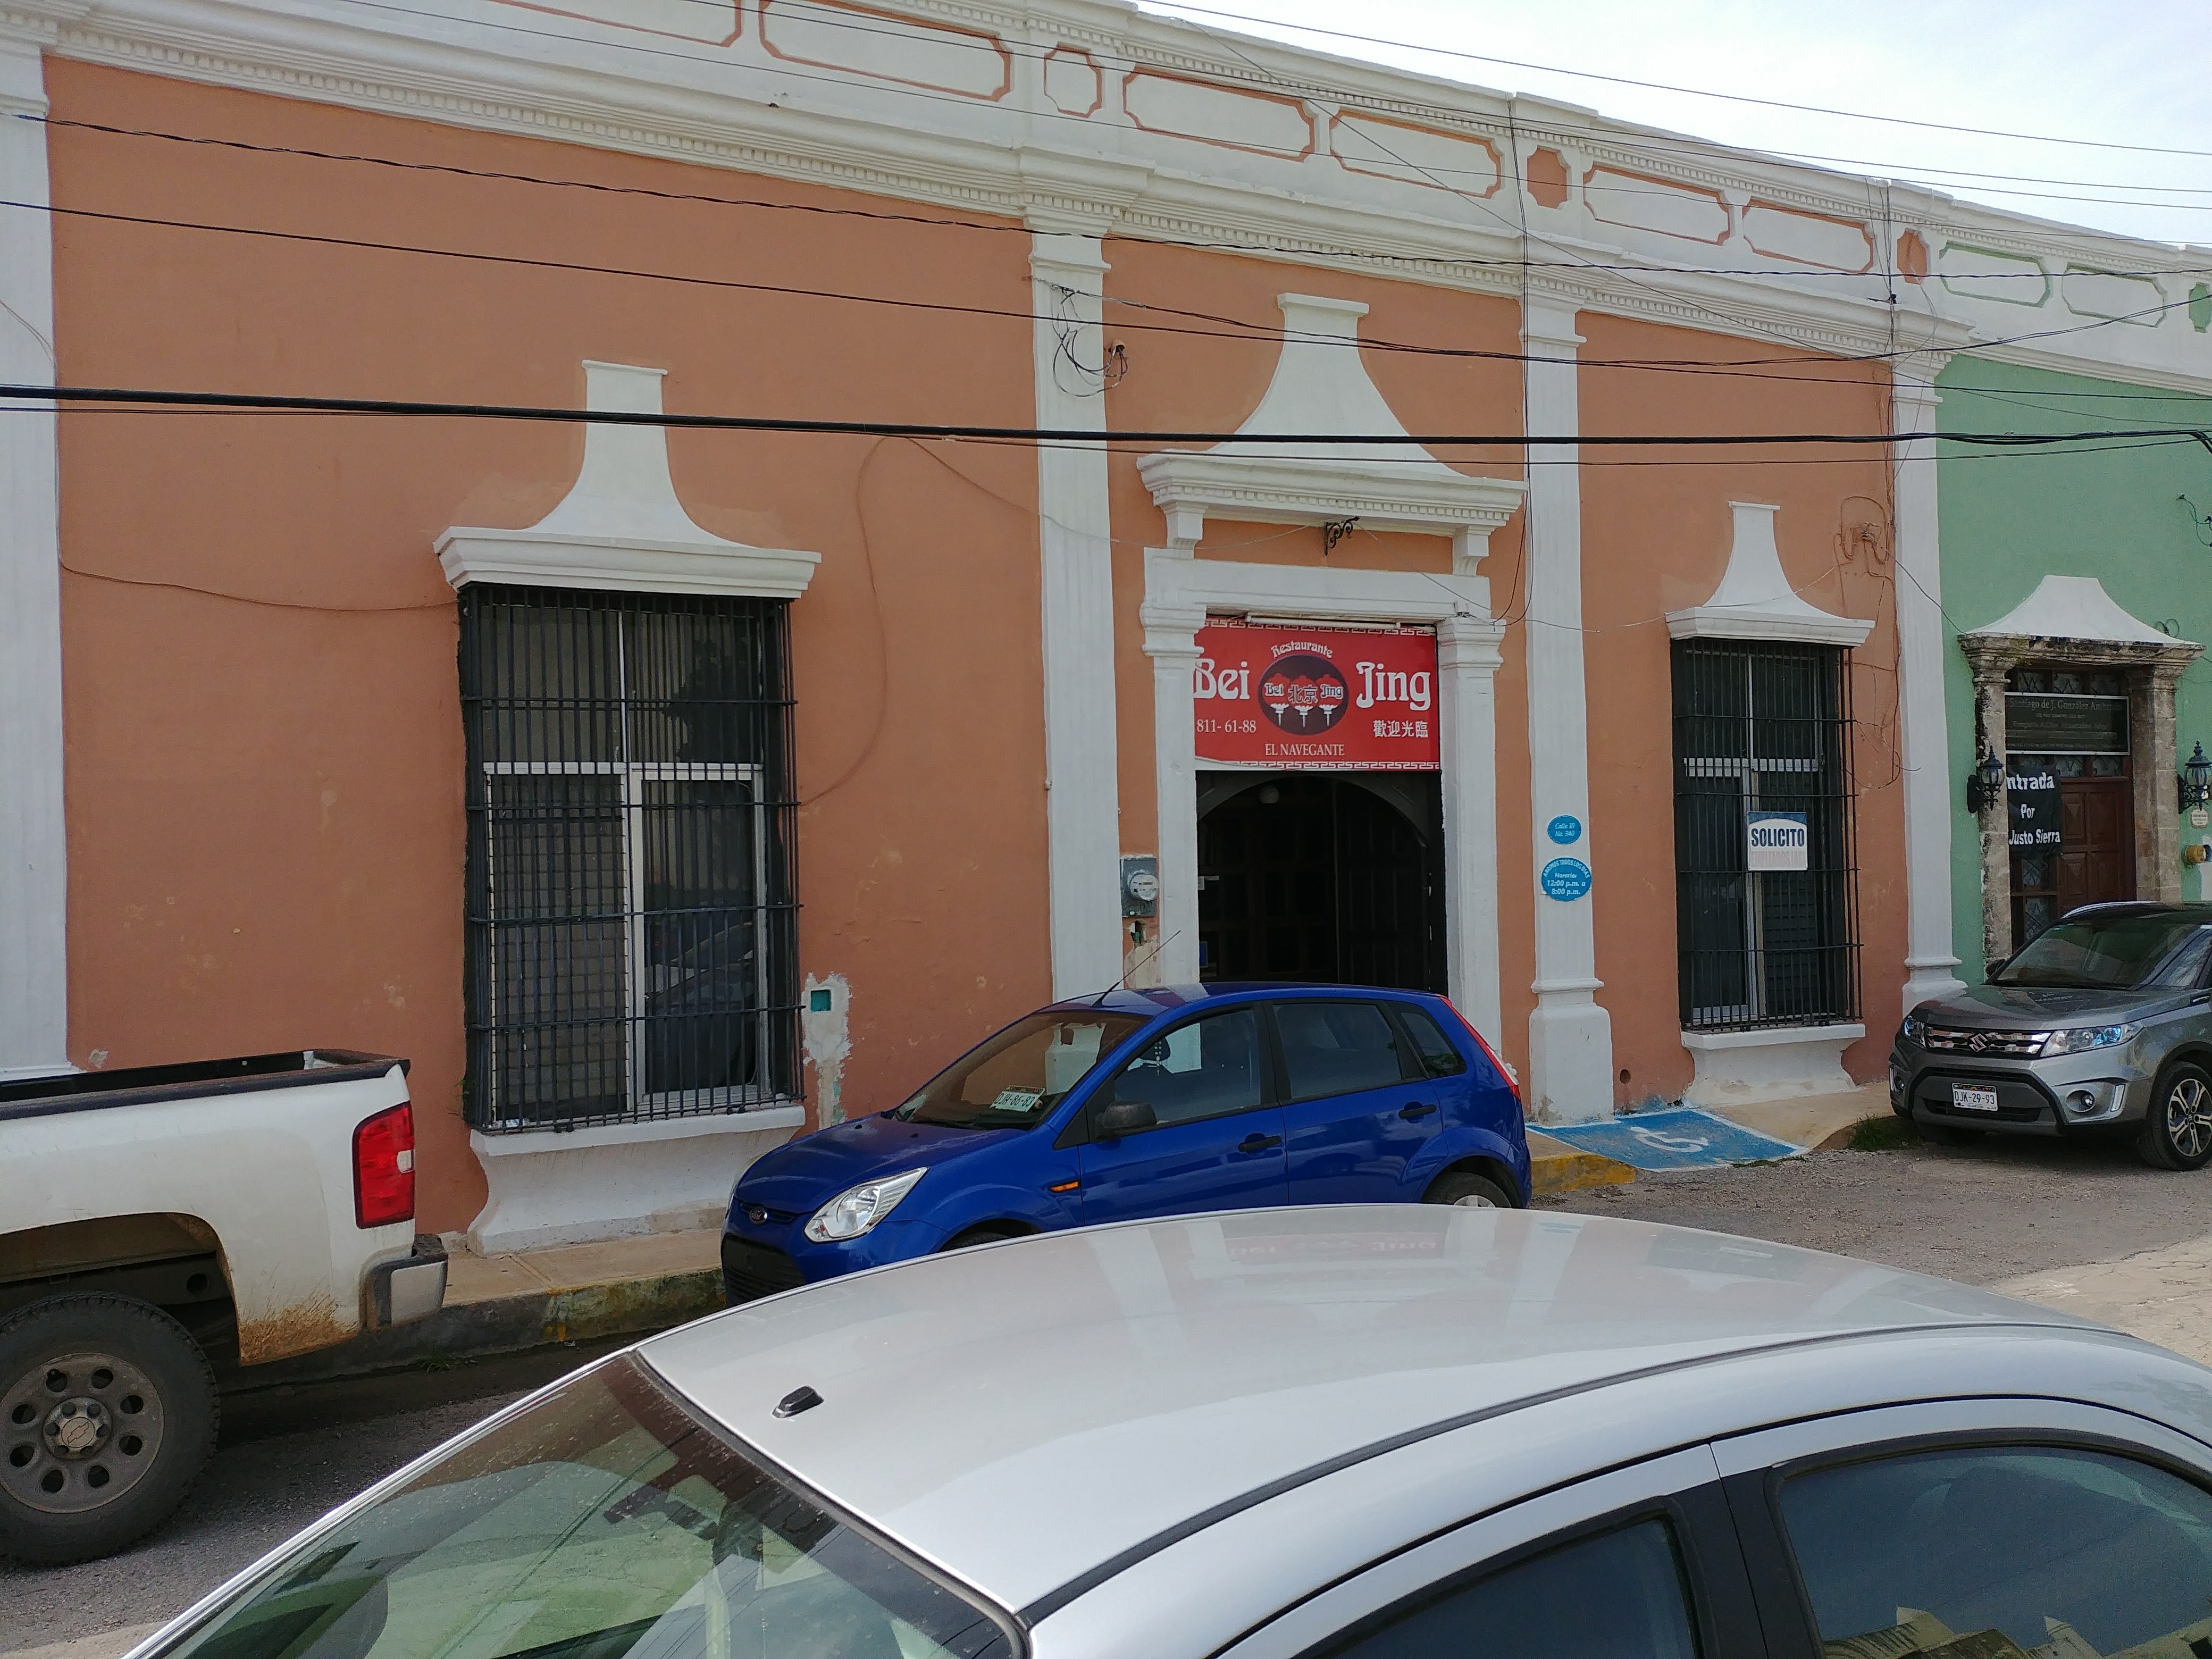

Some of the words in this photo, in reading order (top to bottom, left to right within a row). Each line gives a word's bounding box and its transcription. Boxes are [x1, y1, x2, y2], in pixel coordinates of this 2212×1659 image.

[1271, 641, 1333, 658] Restaurante
[1193, 658, 1250, 700] Bei
[1355, 661, 1431, 711] Jing
[1264, 683, 1284, 696] Bei
[1320, 684, 1343, 699] Jing
[1288, 685, 1318, 703] 北京
[1225, 719, 1256, 733] 61-88
[1373, 719, 1428, 738] 歡迎光臨
[1266, 743, 1278, 756] EL
[1280, 744, 1345, 756] NAVEGANTE
[2006, 772, 2055, 790] ntrada
[2021, 803, 2035, 819] Por
[1751, 828, 1805, 847] SOLICITO
[2009, 830, 2033, 845] Justo
[2035, 828, 2061, 844] Sierra
[1954, 1091, 1995, 1104] DJK-29-93
